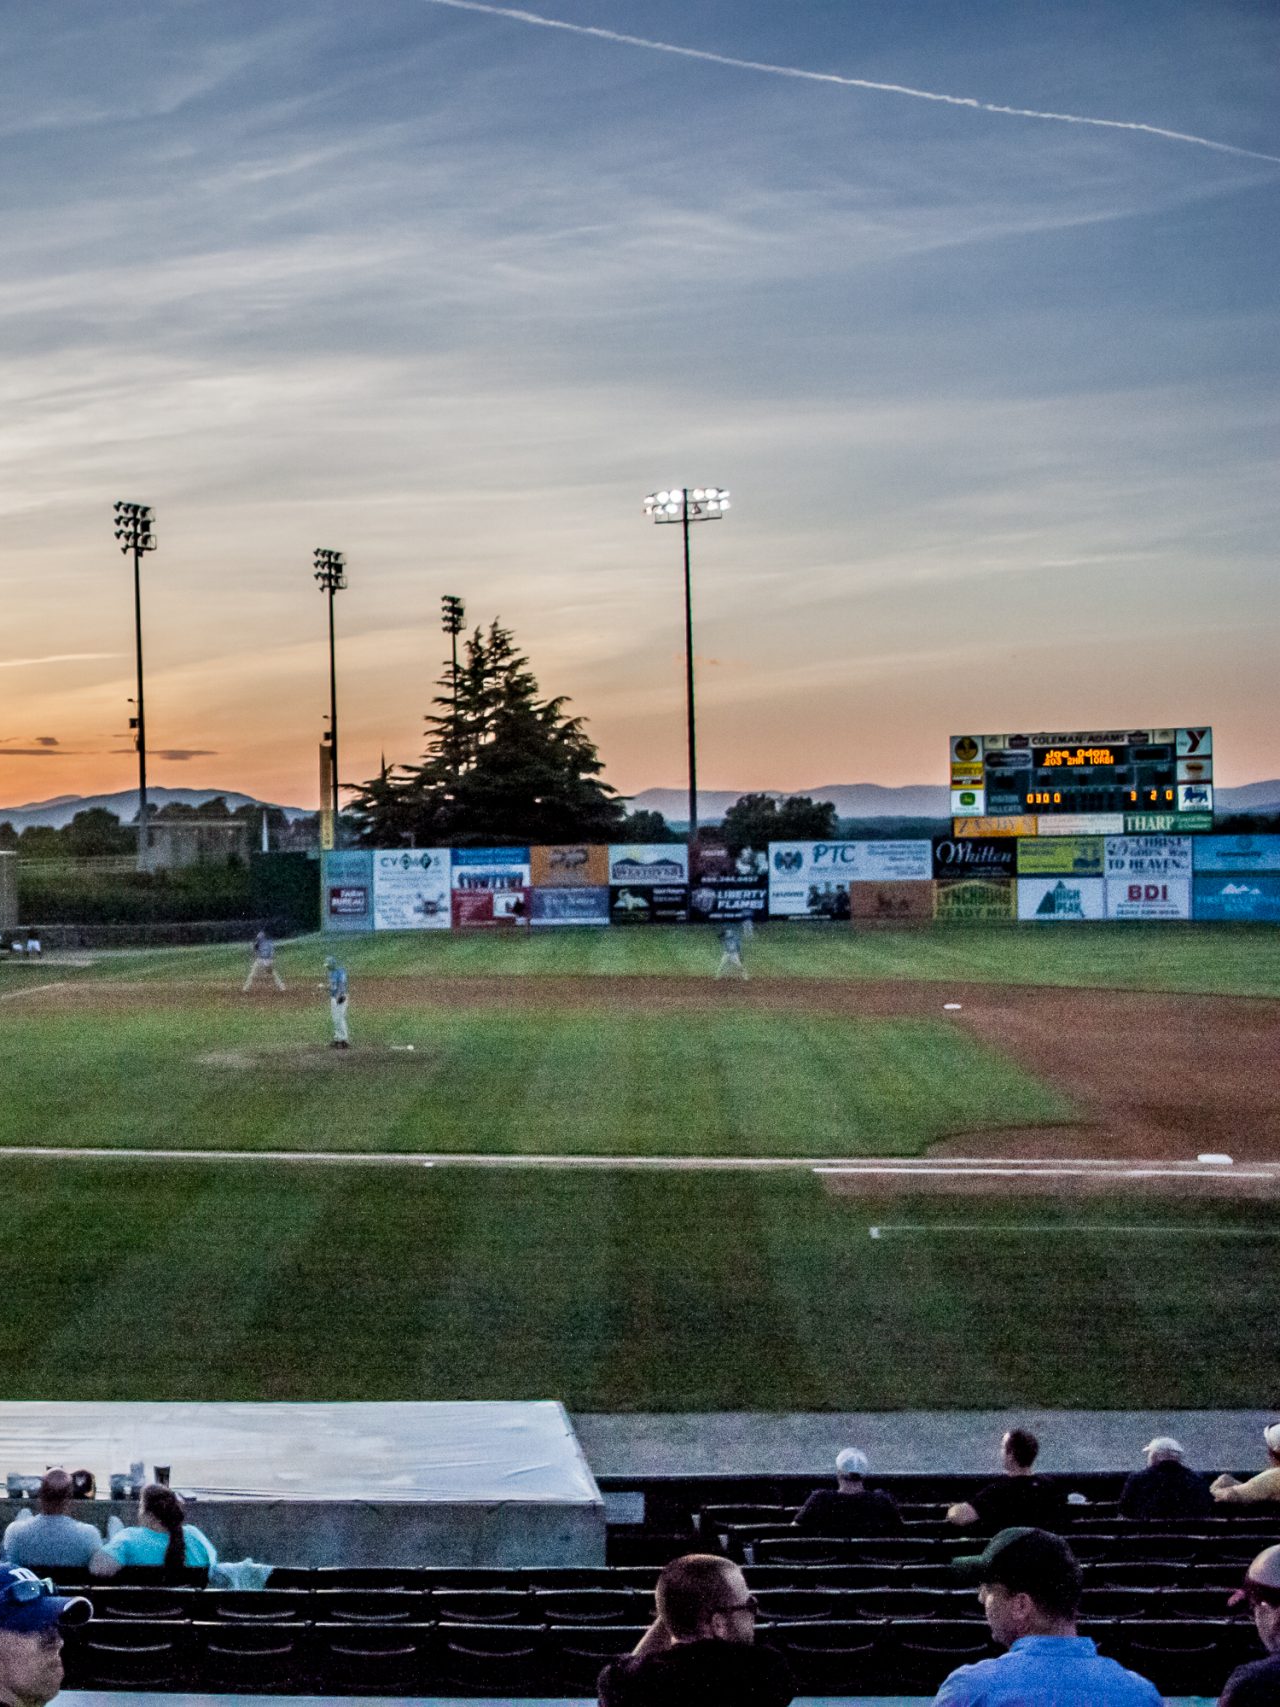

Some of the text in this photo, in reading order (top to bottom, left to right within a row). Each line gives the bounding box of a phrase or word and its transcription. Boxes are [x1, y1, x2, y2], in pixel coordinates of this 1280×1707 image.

[1031, 733, 1125, 746] COLEMAN-ADAMS
[1045, 748, 1110, 759] Joe Odom
[1126, 815, 1175, 831] THARP
[812, 843, 856, 864] PTC
[936, 840, 1012, 863] Whitten
[1107, 859, 1125, 870] TO
[717, 889, 767, 900] LIBERTY
[1128, 884, 1169, 901] BDI
[717, 899, 765, 910] FLAMES
